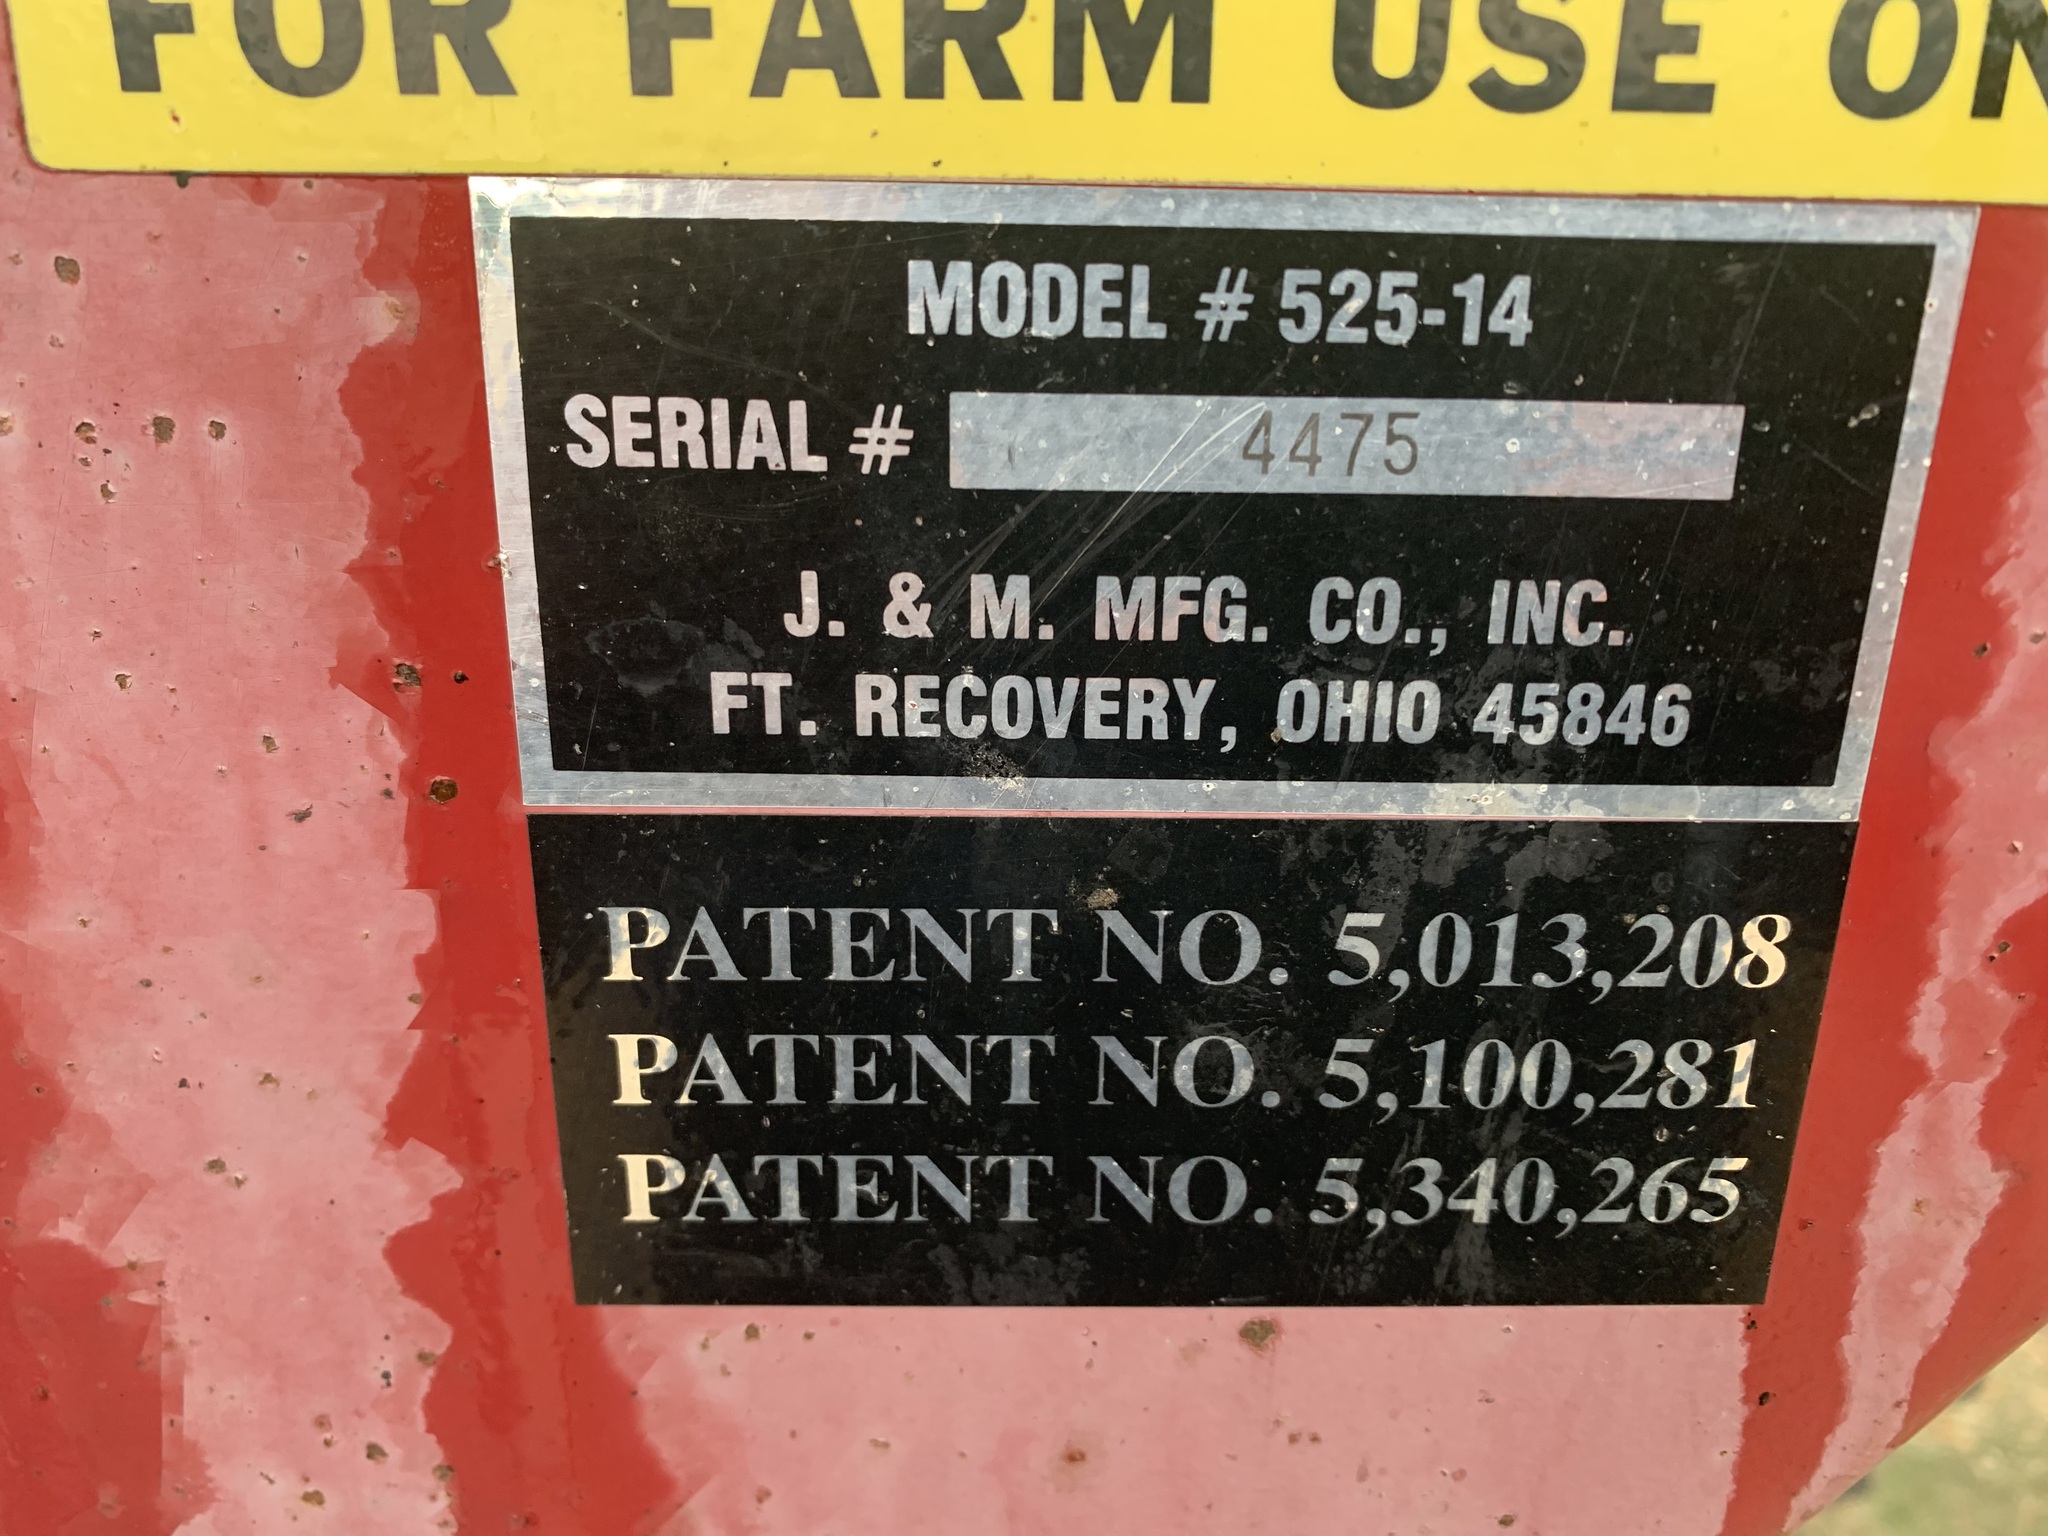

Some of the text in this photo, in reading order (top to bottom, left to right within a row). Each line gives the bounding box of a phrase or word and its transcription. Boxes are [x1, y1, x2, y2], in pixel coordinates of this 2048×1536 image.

[109, 0, 516, 97] FOR
[627, 0, 1213, 103] FARM
[1333, 0, 1715, 113] USE
[908, 260, 1533, 347] MODEL # 525-14
[564, 394, 1418, 475] SERIAL # 4475
[784, 570, 1624, 656] J. & M. MFG. CO., INC.
[710, 671, 1691, 752] FT. RECOVERY, OHIO 45846
[598, 906, 1791, 1003] PATENT NO. 5,013,208
[607, 1034, 1757, 1124] PATENT NO. 5,100,281
[616, 1154, 1748, 1237] PATENT NO. 5,340,265
